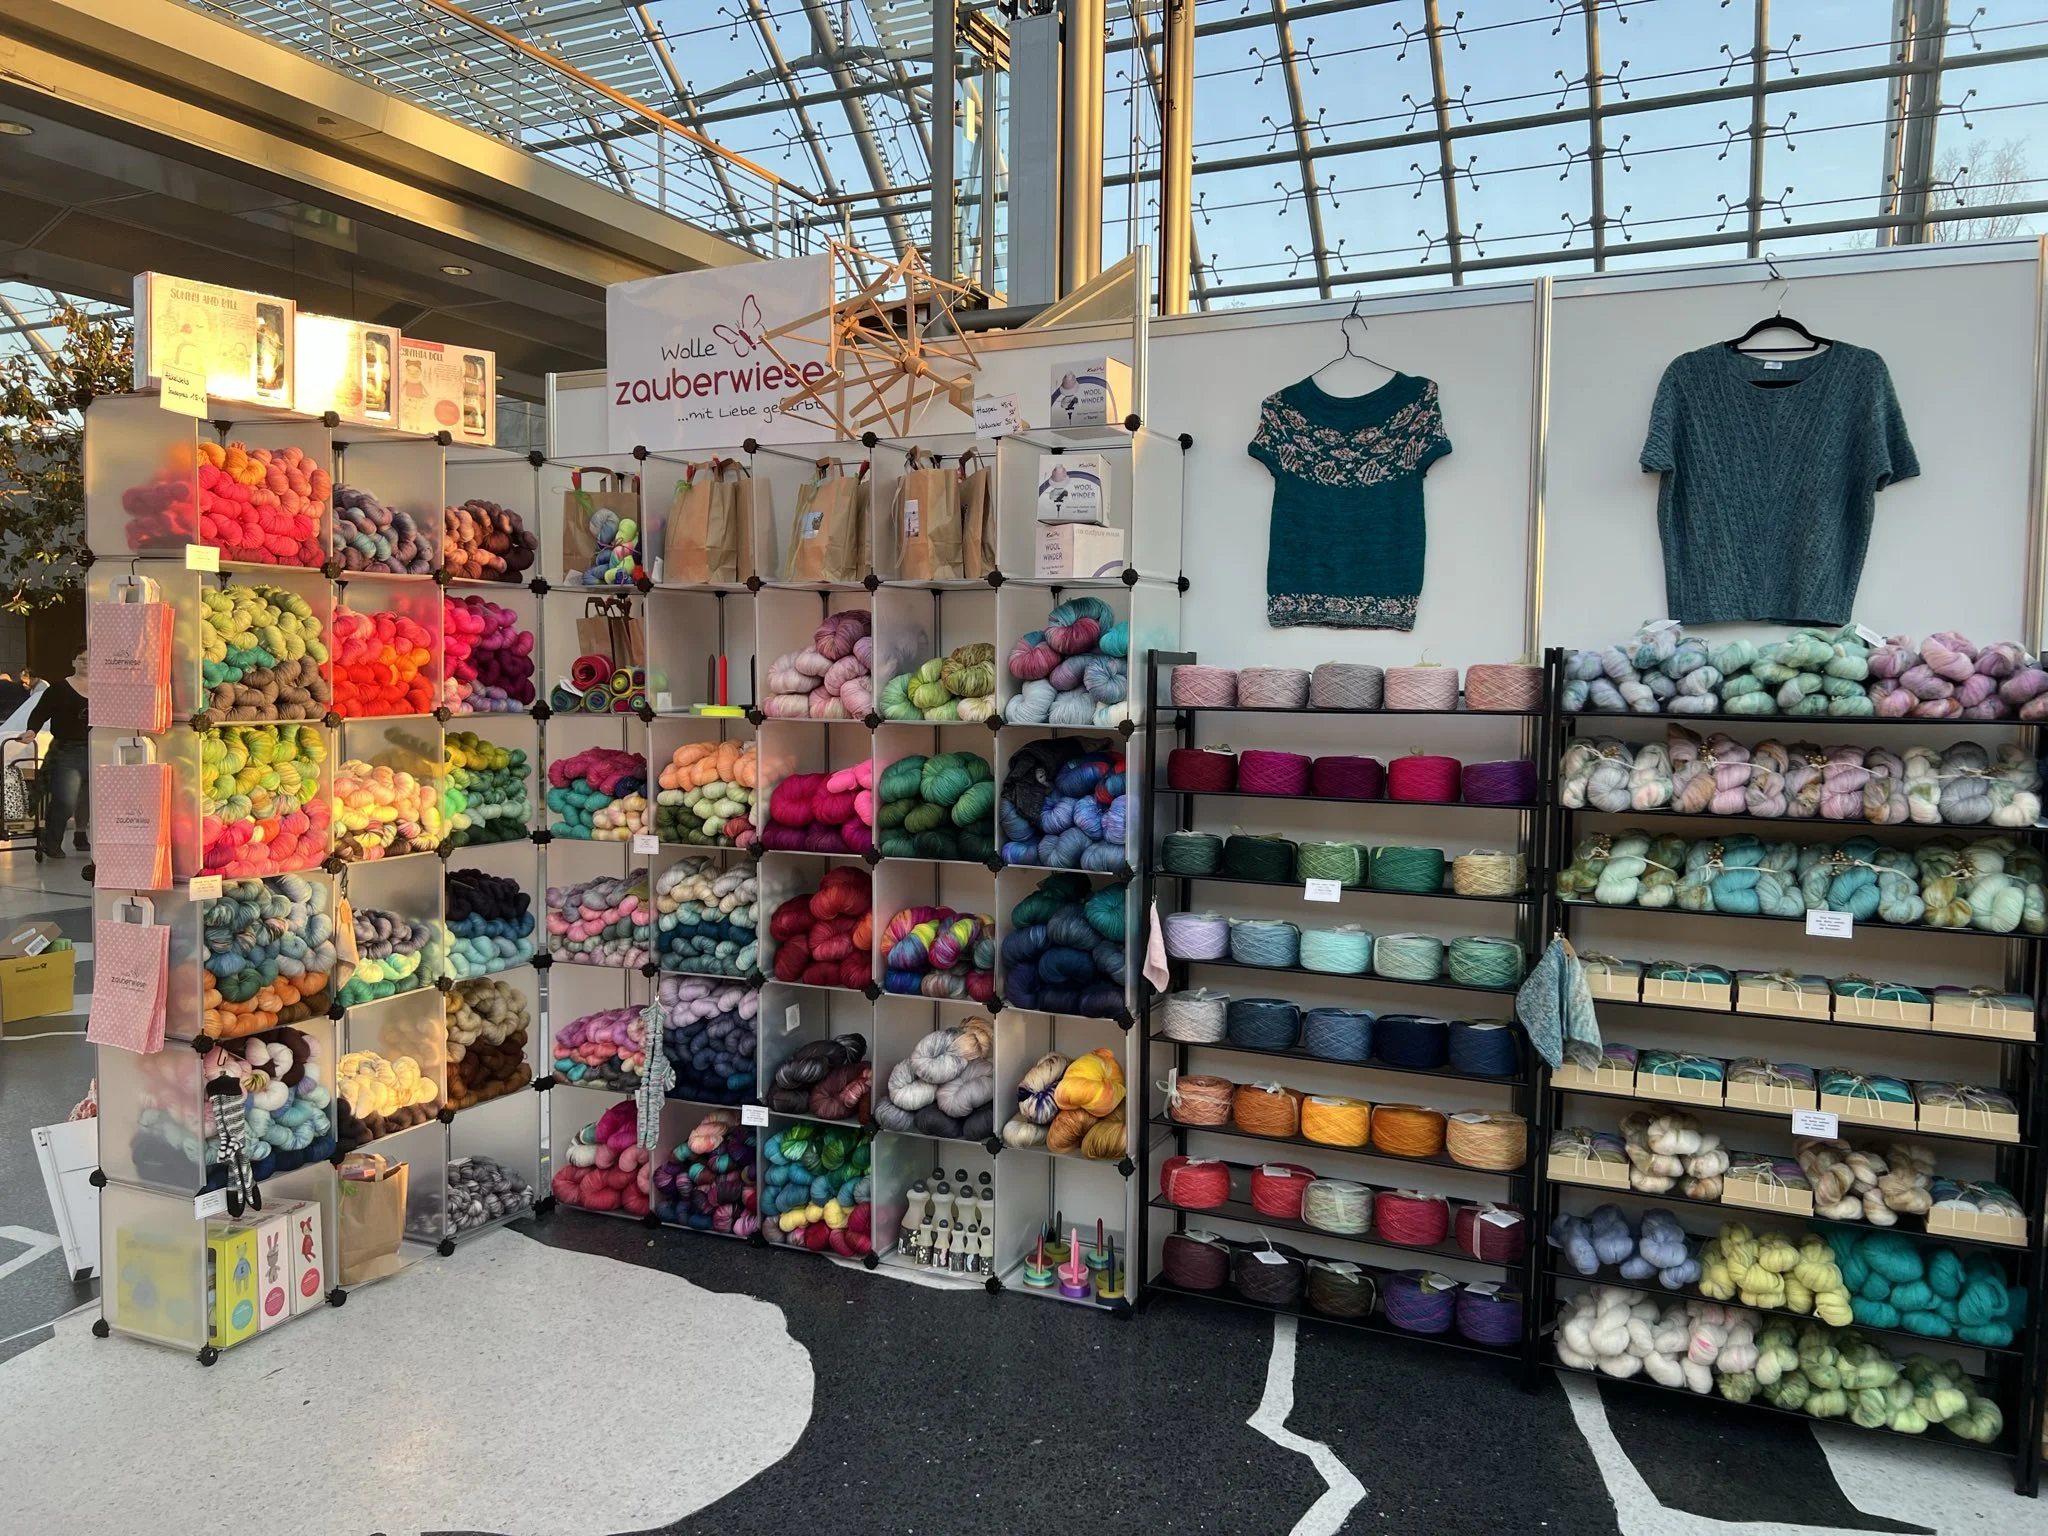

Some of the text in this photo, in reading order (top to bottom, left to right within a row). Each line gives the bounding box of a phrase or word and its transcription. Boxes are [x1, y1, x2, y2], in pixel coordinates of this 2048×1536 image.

[661, 337, 717, 361] Wolle
[615, 361, 825, 406] zauberwiese
[1083, 388, 1102, 397] WOOL
[1080, 396, 1105, 404] WINDER
[719, 404, 757, 419] Liebe
[1045, 543, 1061, 551] WOOL
[1042, 552, 1063, 561] WINDER
